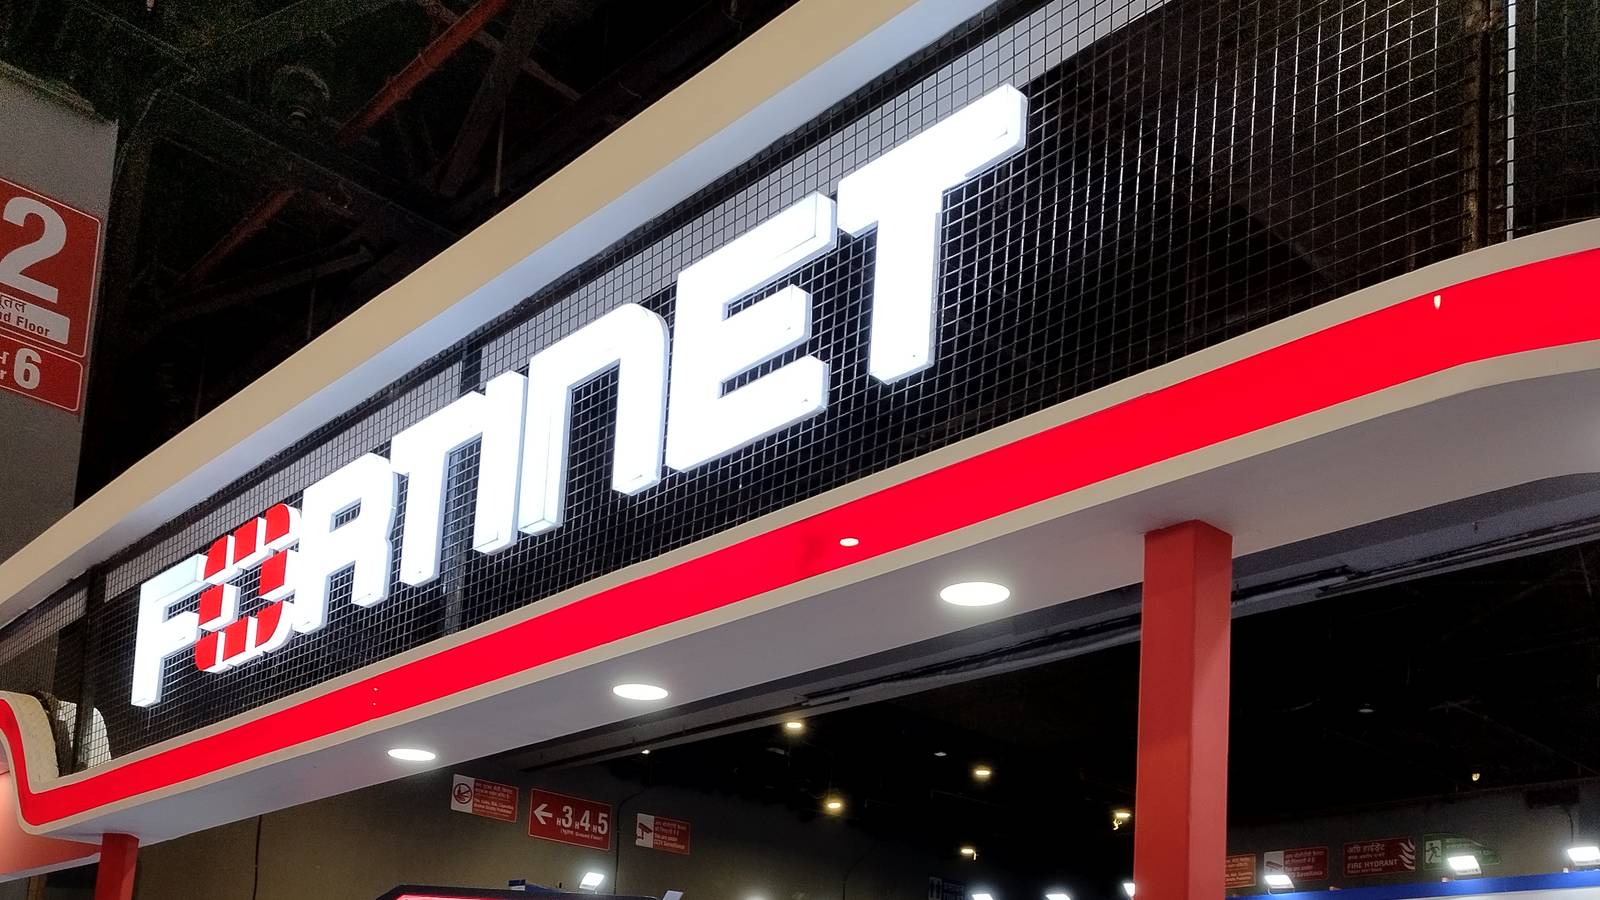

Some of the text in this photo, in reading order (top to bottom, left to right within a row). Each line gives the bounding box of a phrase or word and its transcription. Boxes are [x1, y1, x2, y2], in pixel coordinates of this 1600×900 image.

[0, 196, 67, 304] 2
[17, 315, 50, 337] Floor
[14, 348, 42, 389] 6
[130, 83, 1028, 708] FORTINET
[1347, 859, 1399, 870] FIRE HYDRANT
